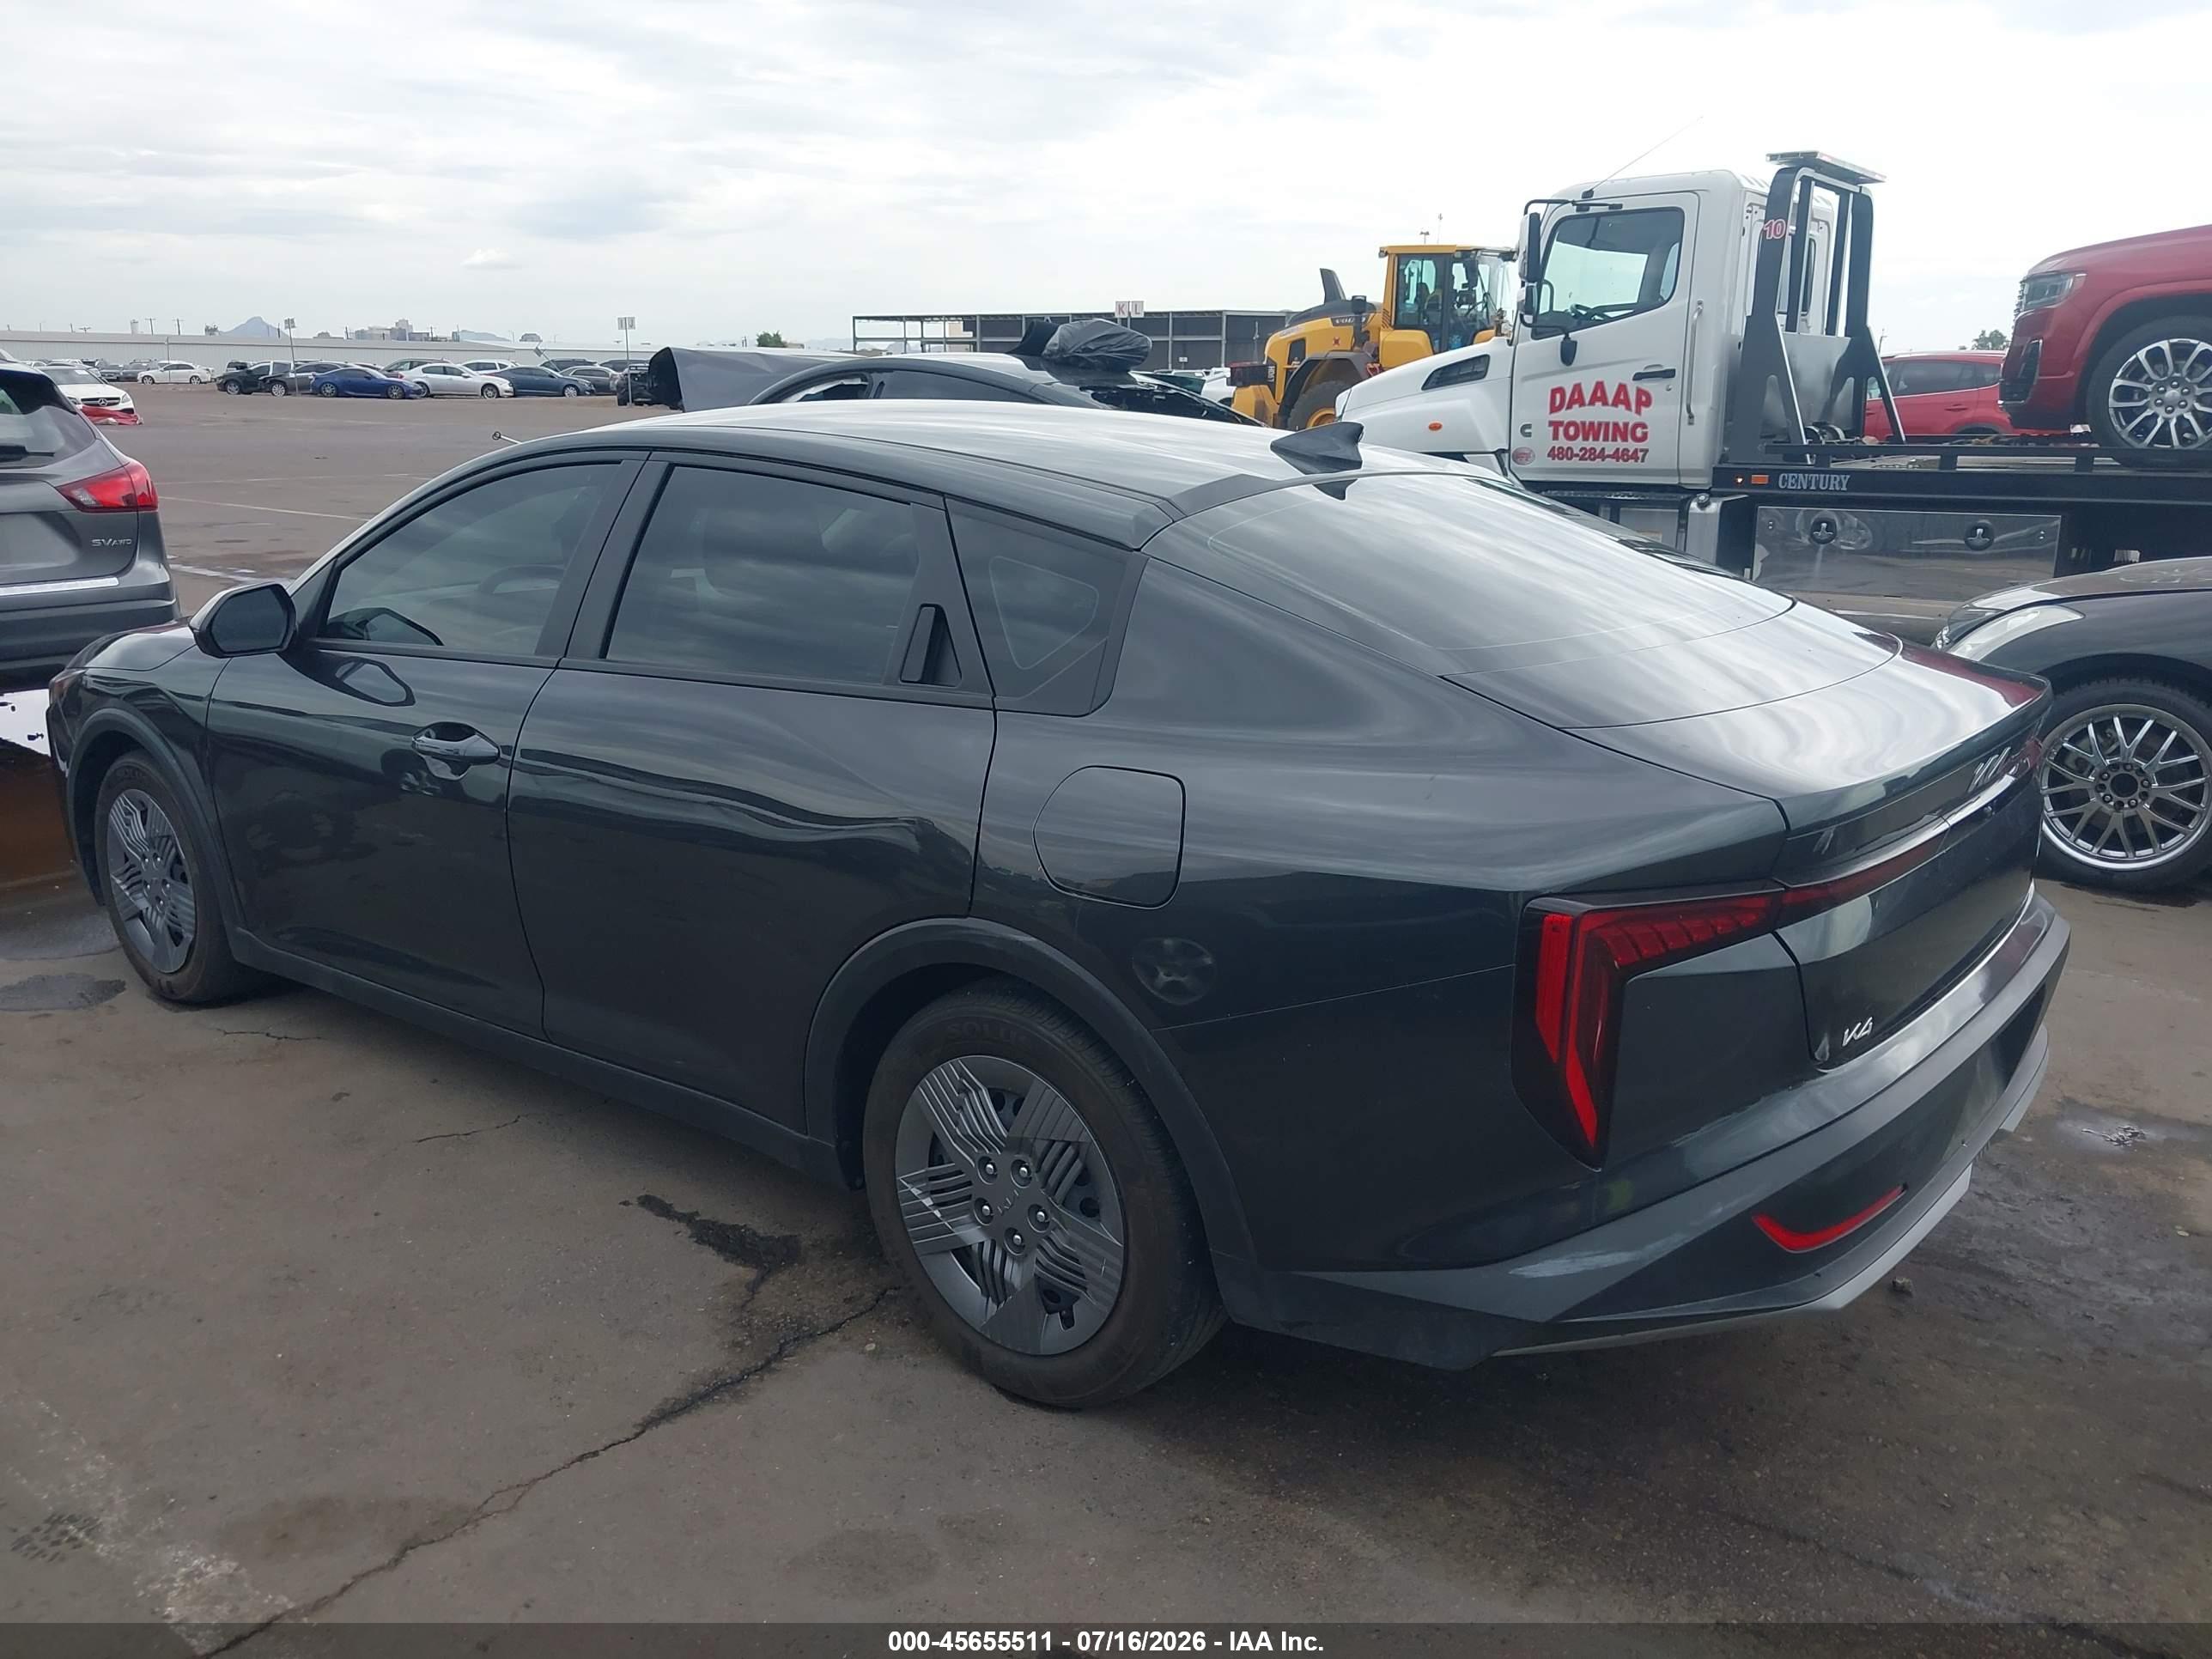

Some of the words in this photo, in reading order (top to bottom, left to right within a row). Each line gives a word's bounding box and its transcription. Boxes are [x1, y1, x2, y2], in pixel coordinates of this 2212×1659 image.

[1764, 219, 1786, 240] 10
[1548, 380, 1653, 416] DAAAP
[1547, 420, 1649, 444] TOWING
[1547, 446, 1650, 463] 480-284-4647
[1778, 472, 1850, 491] CENTURY
[91, 538, 112, 547] SV
[1842, 1016, 1873, 1047] K4
